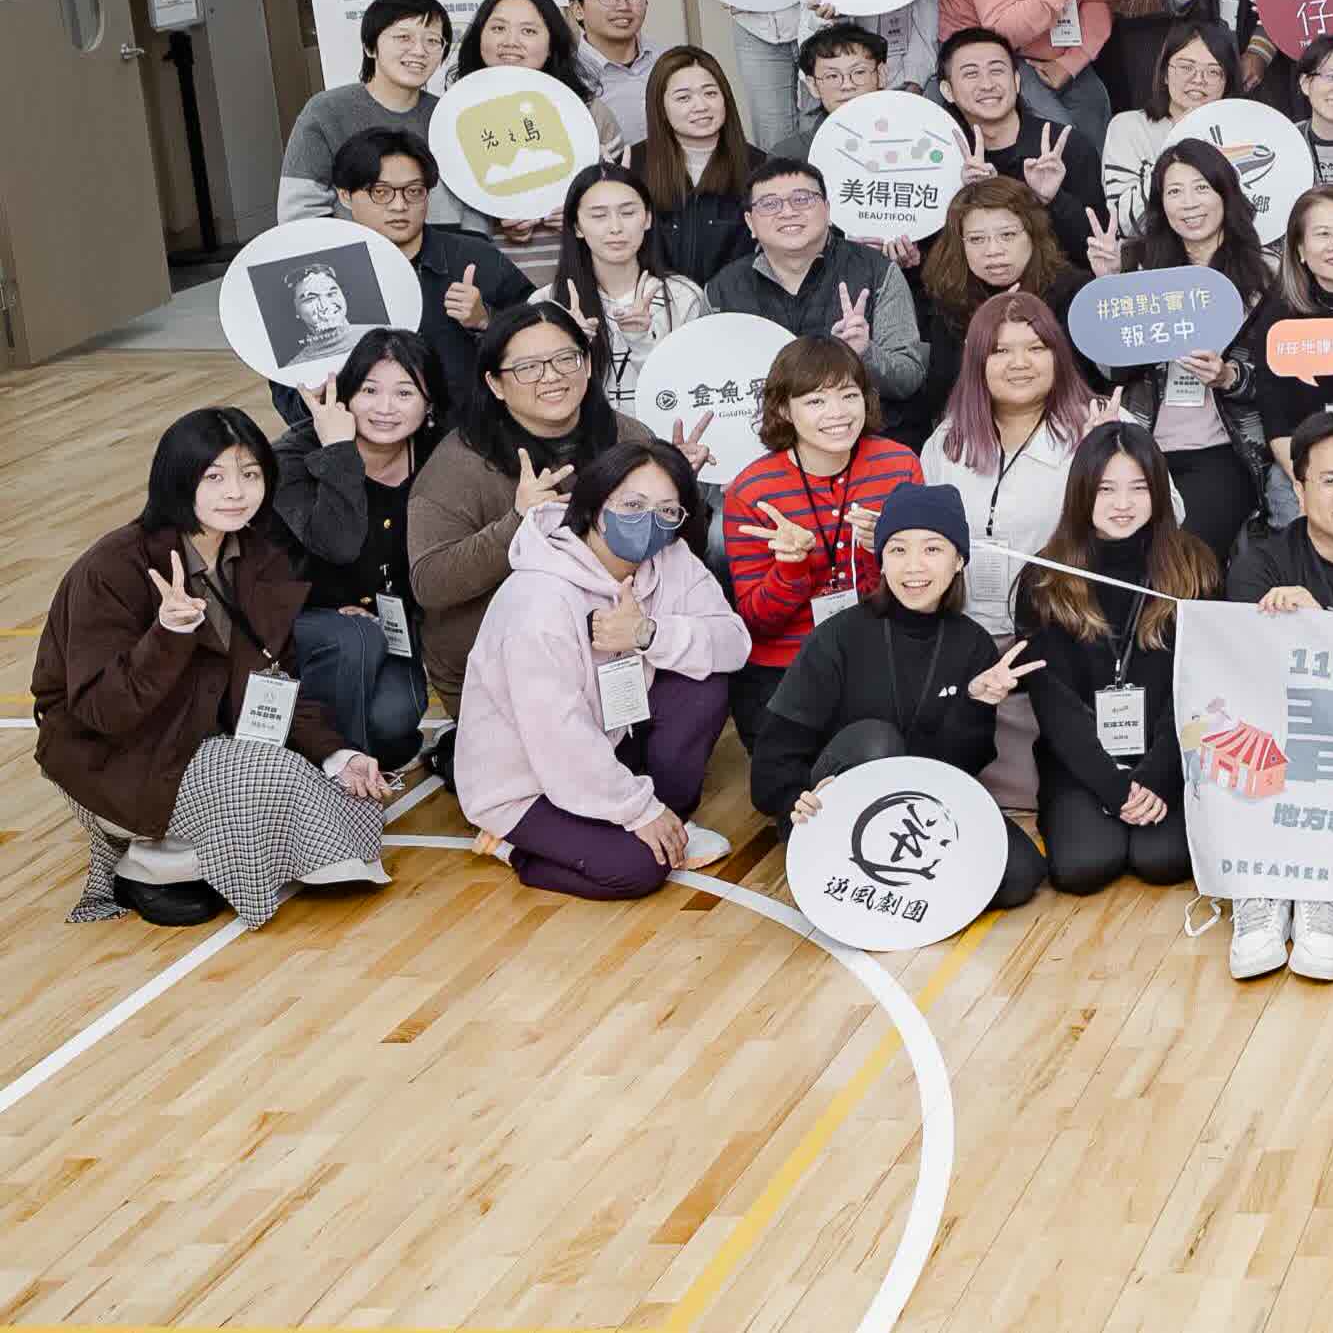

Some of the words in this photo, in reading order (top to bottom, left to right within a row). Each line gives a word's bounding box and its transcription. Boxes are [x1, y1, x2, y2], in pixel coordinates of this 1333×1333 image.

[840, 178, 939, 209] 美得冒泡
[1120, 320, 1195, 348] 報名中
[1221, 859, 1330, 881] DREAMER
